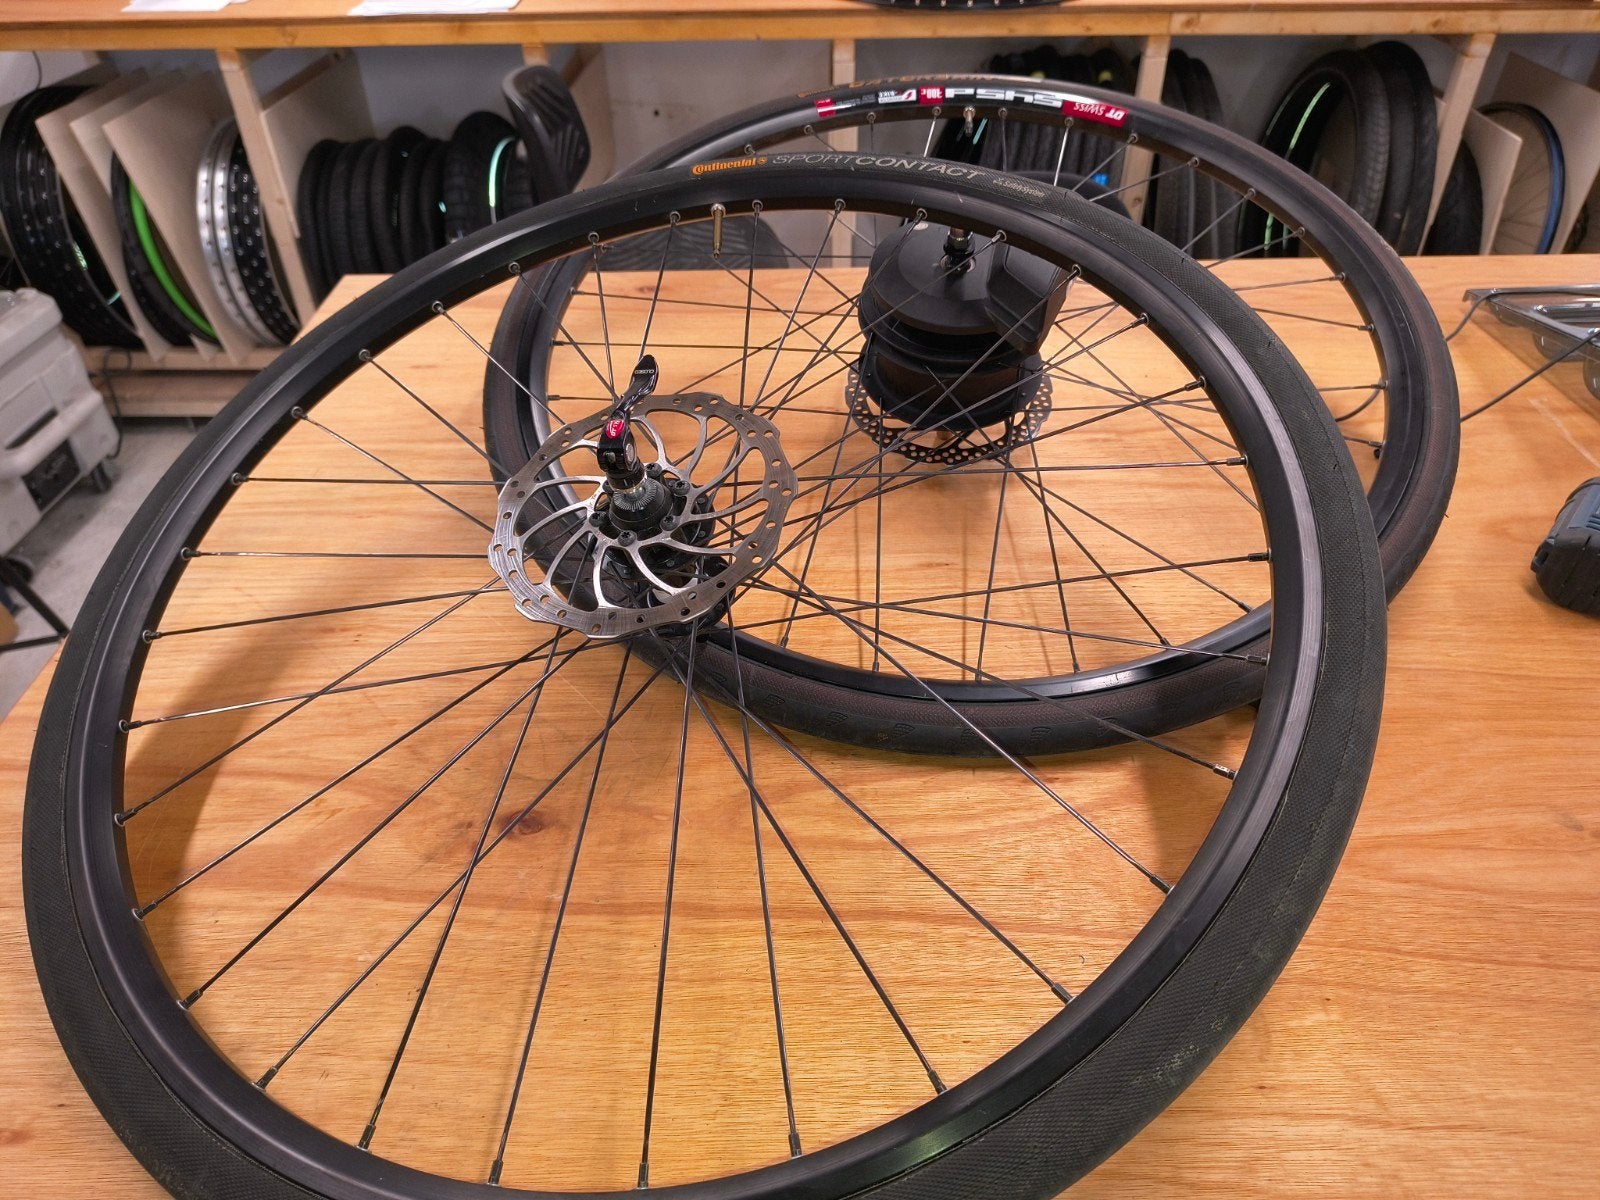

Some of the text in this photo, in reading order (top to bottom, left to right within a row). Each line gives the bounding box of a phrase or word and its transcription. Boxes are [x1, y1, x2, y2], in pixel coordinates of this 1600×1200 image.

[1073, 102, 1105, 116] SWISS
[1105, 108, 1125, 121] DT
[692, 157, 757, 175] Continental
[772, 153, 986, 180] SPORTCONTACT
